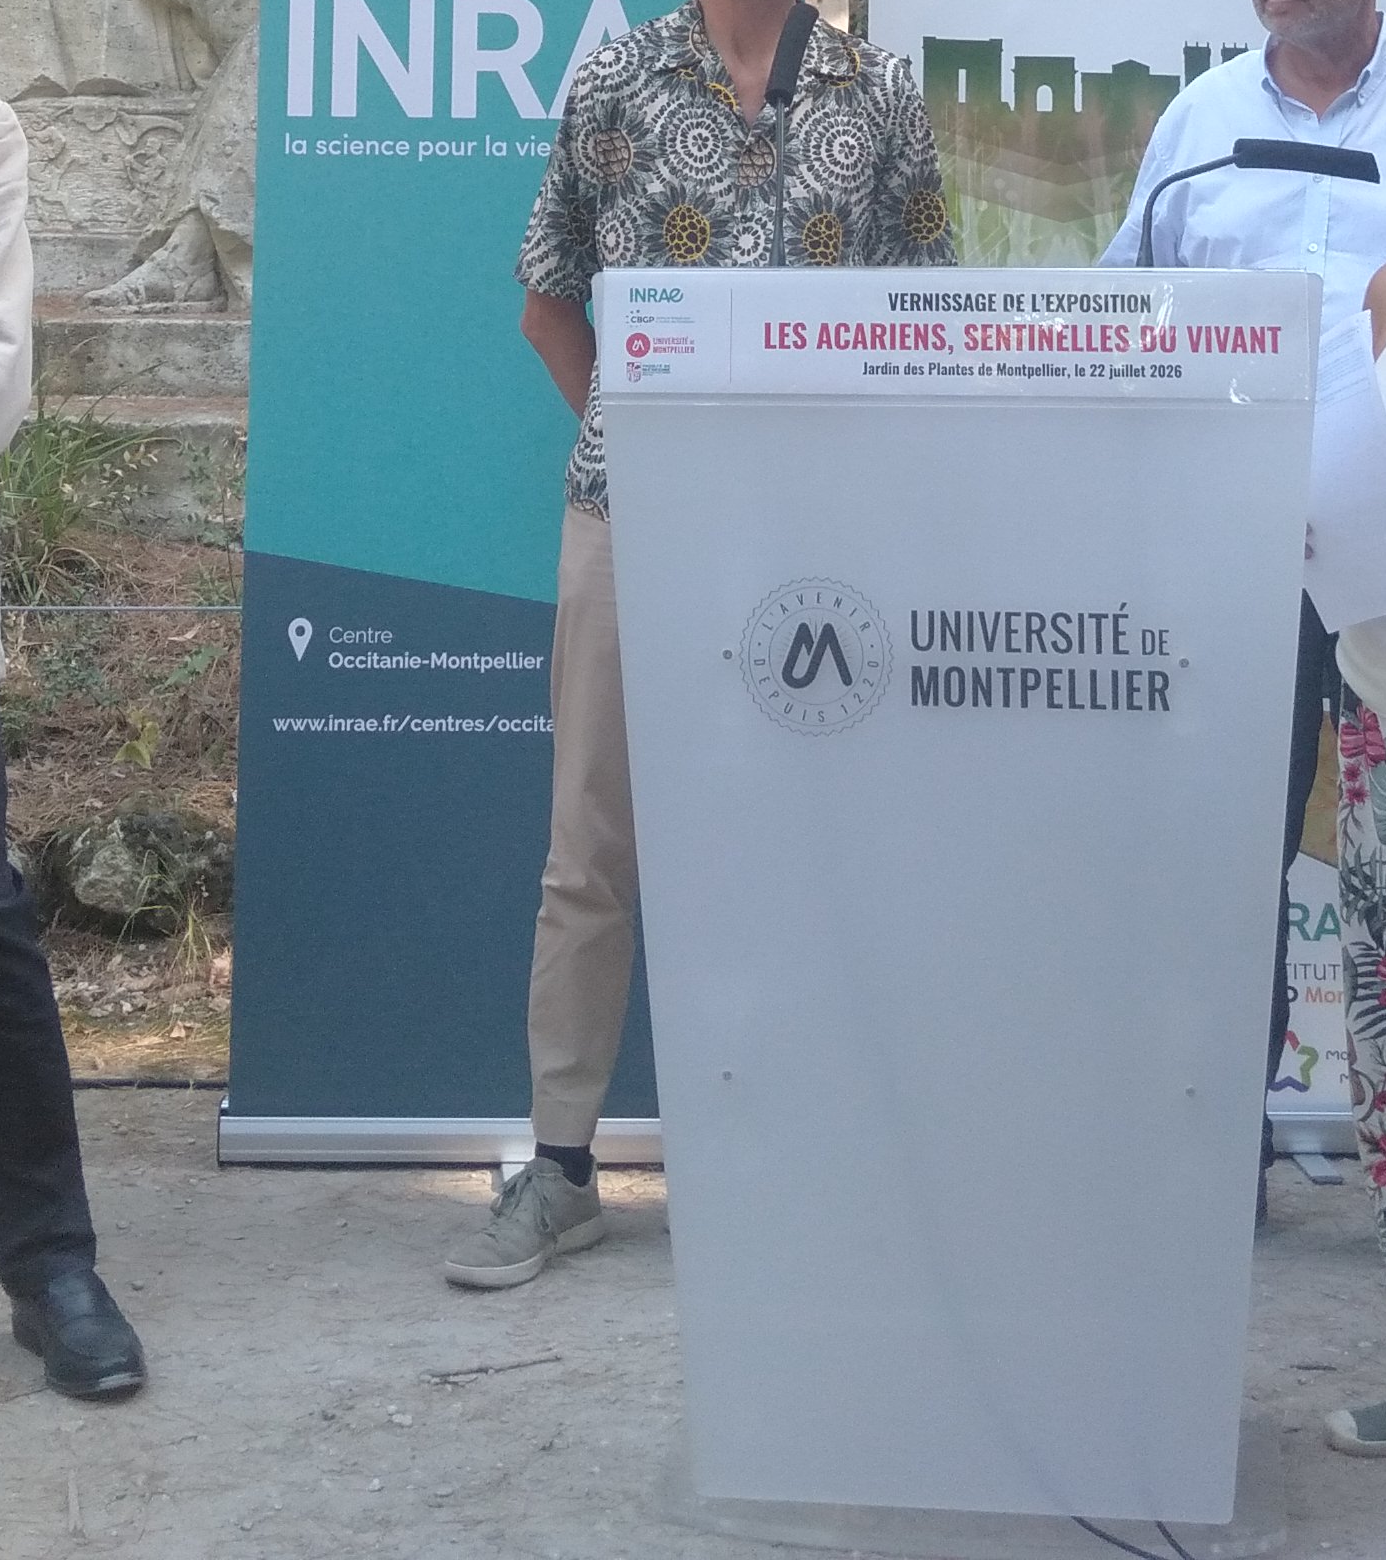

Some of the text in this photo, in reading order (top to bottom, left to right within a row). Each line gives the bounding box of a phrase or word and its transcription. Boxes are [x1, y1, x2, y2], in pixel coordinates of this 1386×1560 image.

[285, 133, 551, 162] la science pour la vie
[888, 293, 1151, 313] VERNISSAGE DE L'EXPOSITION
[630, 316, 655, 324] CBGP
[764, 322, 1282, 355] LES ACARIENS, SENTINELLES DU VIVANT
[862, 361, 1183, 380] Jardin des Plantes de Montpellier, le 22 juillet 2026
[329, 627, 393, 644] Centre
[911, 602, 1170, 656] UNIVERSITÉ DE
[329, 652, 544, 673] Occitanie-Montpellier
[911, 666, 1171, 711] MONTPELLIER
